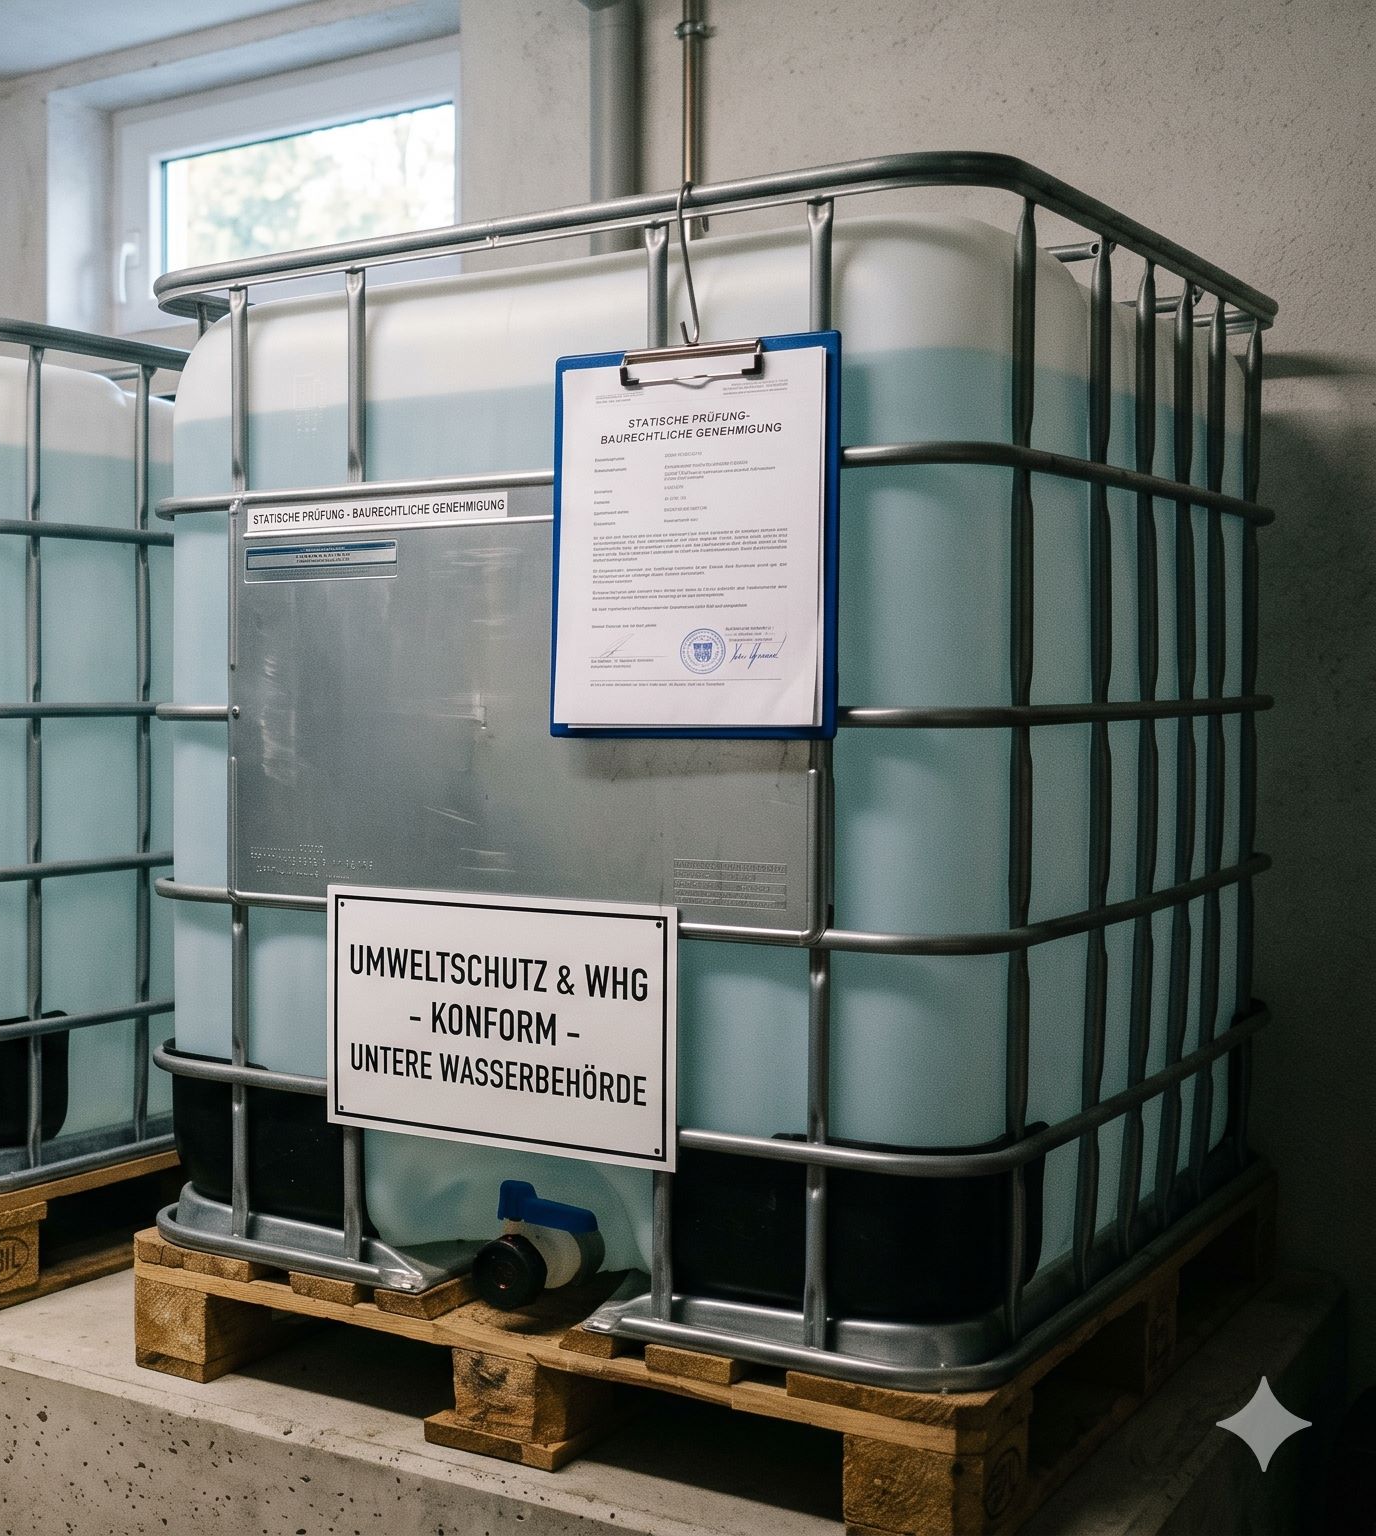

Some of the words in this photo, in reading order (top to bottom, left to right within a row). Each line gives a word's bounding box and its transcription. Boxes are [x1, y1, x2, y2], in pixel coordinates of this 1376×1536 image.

[600, 429, 693, 445] BAURECHTLICHE
[696, 422, 782, 438] GENEHMIGUNG
[628, 415, 689, 428] STATISCHE
[692, 411, 751, 424] PRÜFUNG-
[253, 511, 300, 525] STATISCHE
[302, 508, 345, 522] PRÜFUNG
[352, 503, 430, 519] BAURECHTLICHE
[432, 499, 505, 514] GENEHMIGUNG
[350, 943, 548, 993] UMWELTSCHUTZ
[556, 964, 575, 996] &
[584, 963, 649, 1002] WHG
[431, 1001, 557, 1047] KONFORM
[350, 1042, 433, 1080] UNTERE
[439, 1052, 647, 1107] WASSERBEHÖRDE
